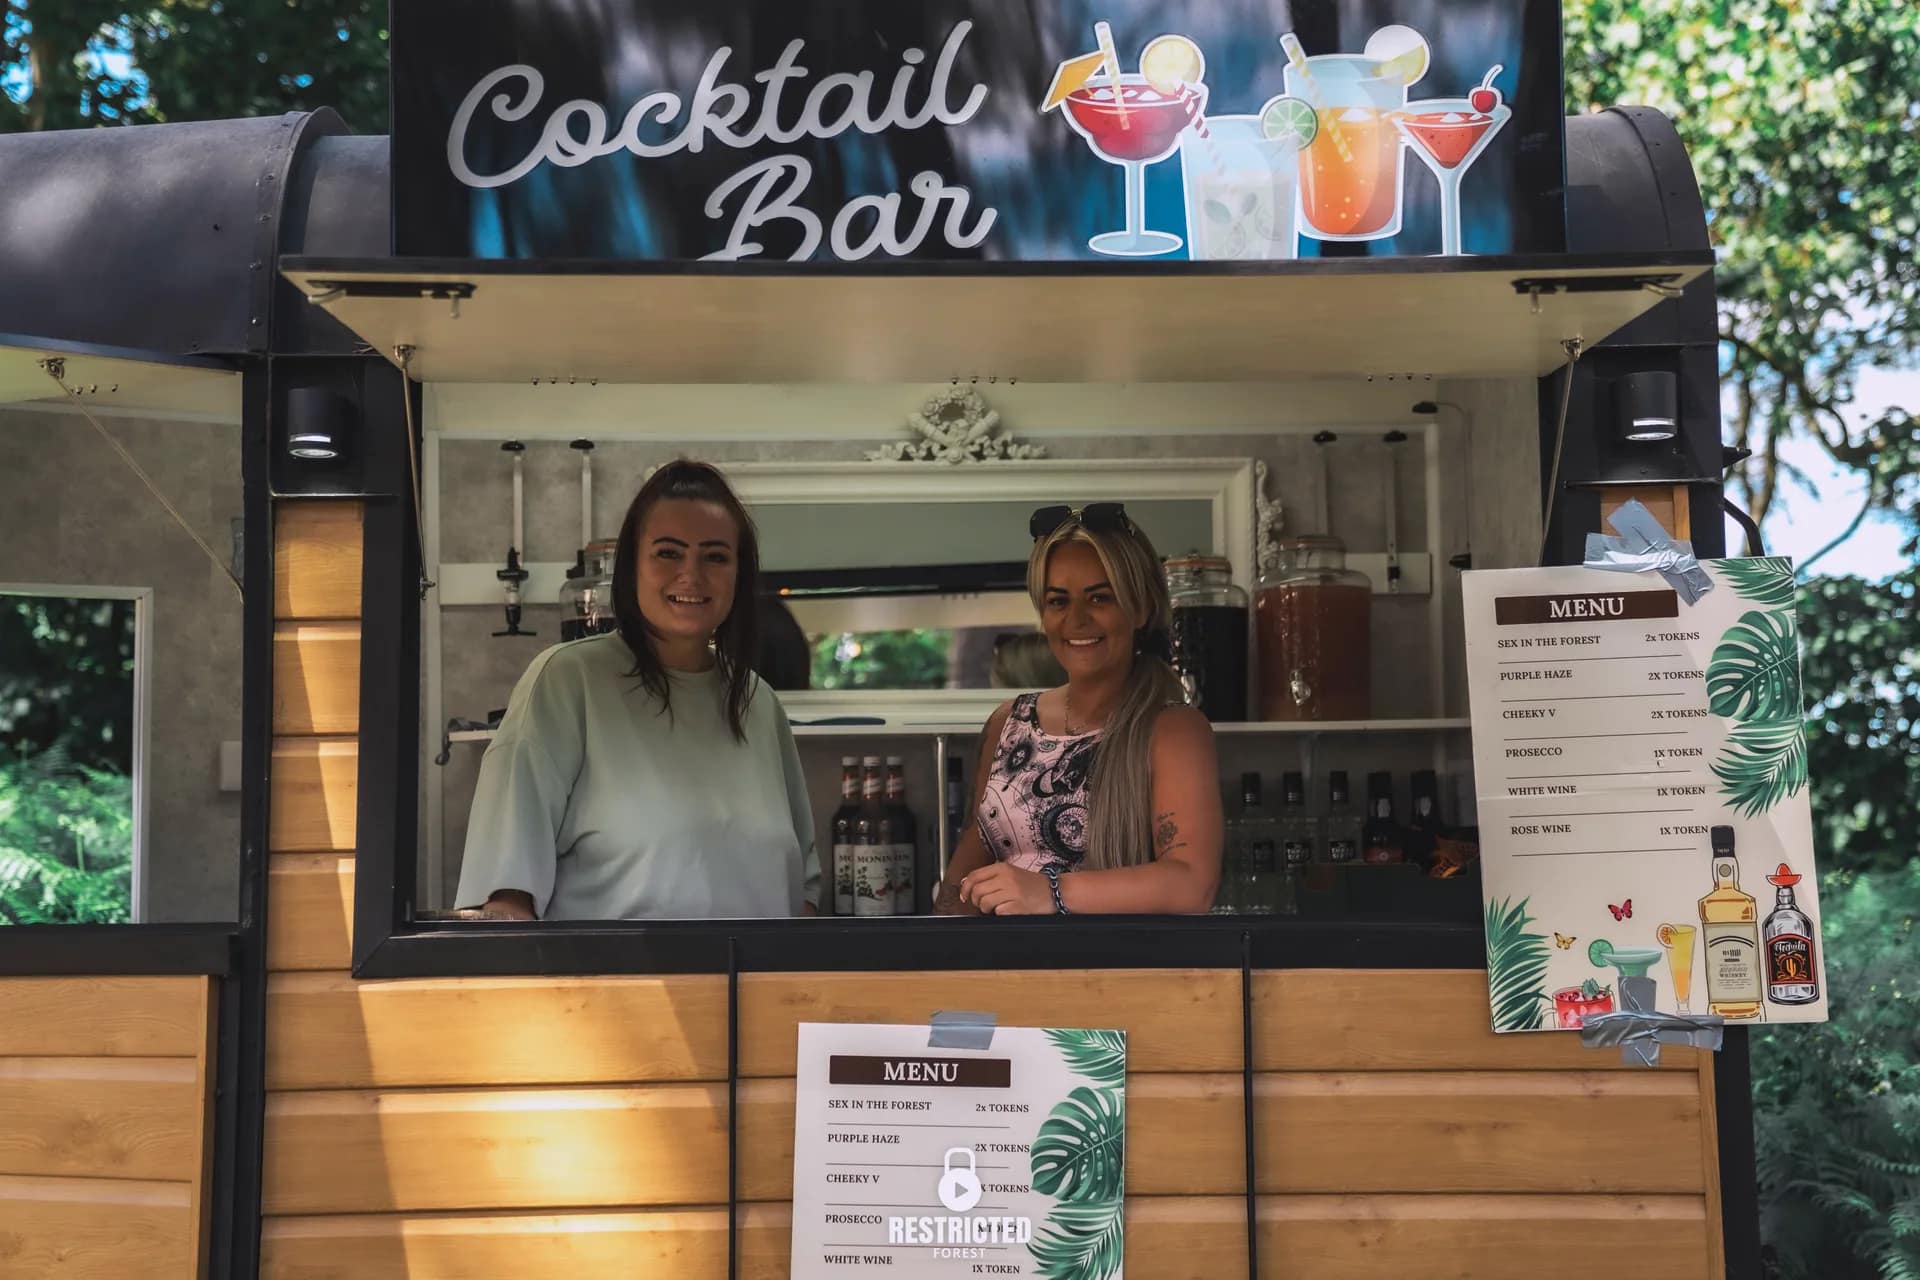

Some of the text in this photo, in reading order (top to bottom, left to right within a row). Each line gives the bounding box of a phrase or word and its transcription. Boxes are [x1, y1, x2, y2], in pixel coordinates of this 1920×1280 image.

[447, 19, 989, 190] Cocktail
[696, 154, 998, 262] Bar
[1549, 597, 1625, 619] MENU
[1497, 635, 1601, 649] SEX IN THE FOREST
[1659, 632, 1700, 642] TOKENS
[1500, 669, 1573, 681] PURPLE HAZE
[1648, 670, 1704, 681] 2X TOKENS
[1502, 708, 1557, 719] CHEEKY V
[1651, 708, 1708, 719] 2X TOKENS
[1505, 747, 1563, 758] PROSECCO
[1654, 748, 1703, 758] 1X TOKEN
[1508, 785, 1577, 796] WHITE WINE
[1657, 786, 1706, 797] 1X TOKEN
[1511, 824, 1572, 835] ROSE WINE
[1660, 825, 1709, 835] 1X TOKEN
[883, 1061, 959, 1082] MENU
[828, 1099, 932, 1111] SEX IN THE FOREST
[988, 1104, 1029, 1113] TOKENS
[827, 1134, 900, 1144] PURPLE HAZE
[975, 1144, 1030, 1153] 2X TOKENS
[826, 1174, 880, 1184] CHEEKY V
[989, 1184, 1030, 1194] TOKENS
[825, 1214, 882, 1225] PROSECCO
[824, 1255, 893, 1265] WHITE WINE
[972, 1264, 1021, 1275] 1X TOKEN
